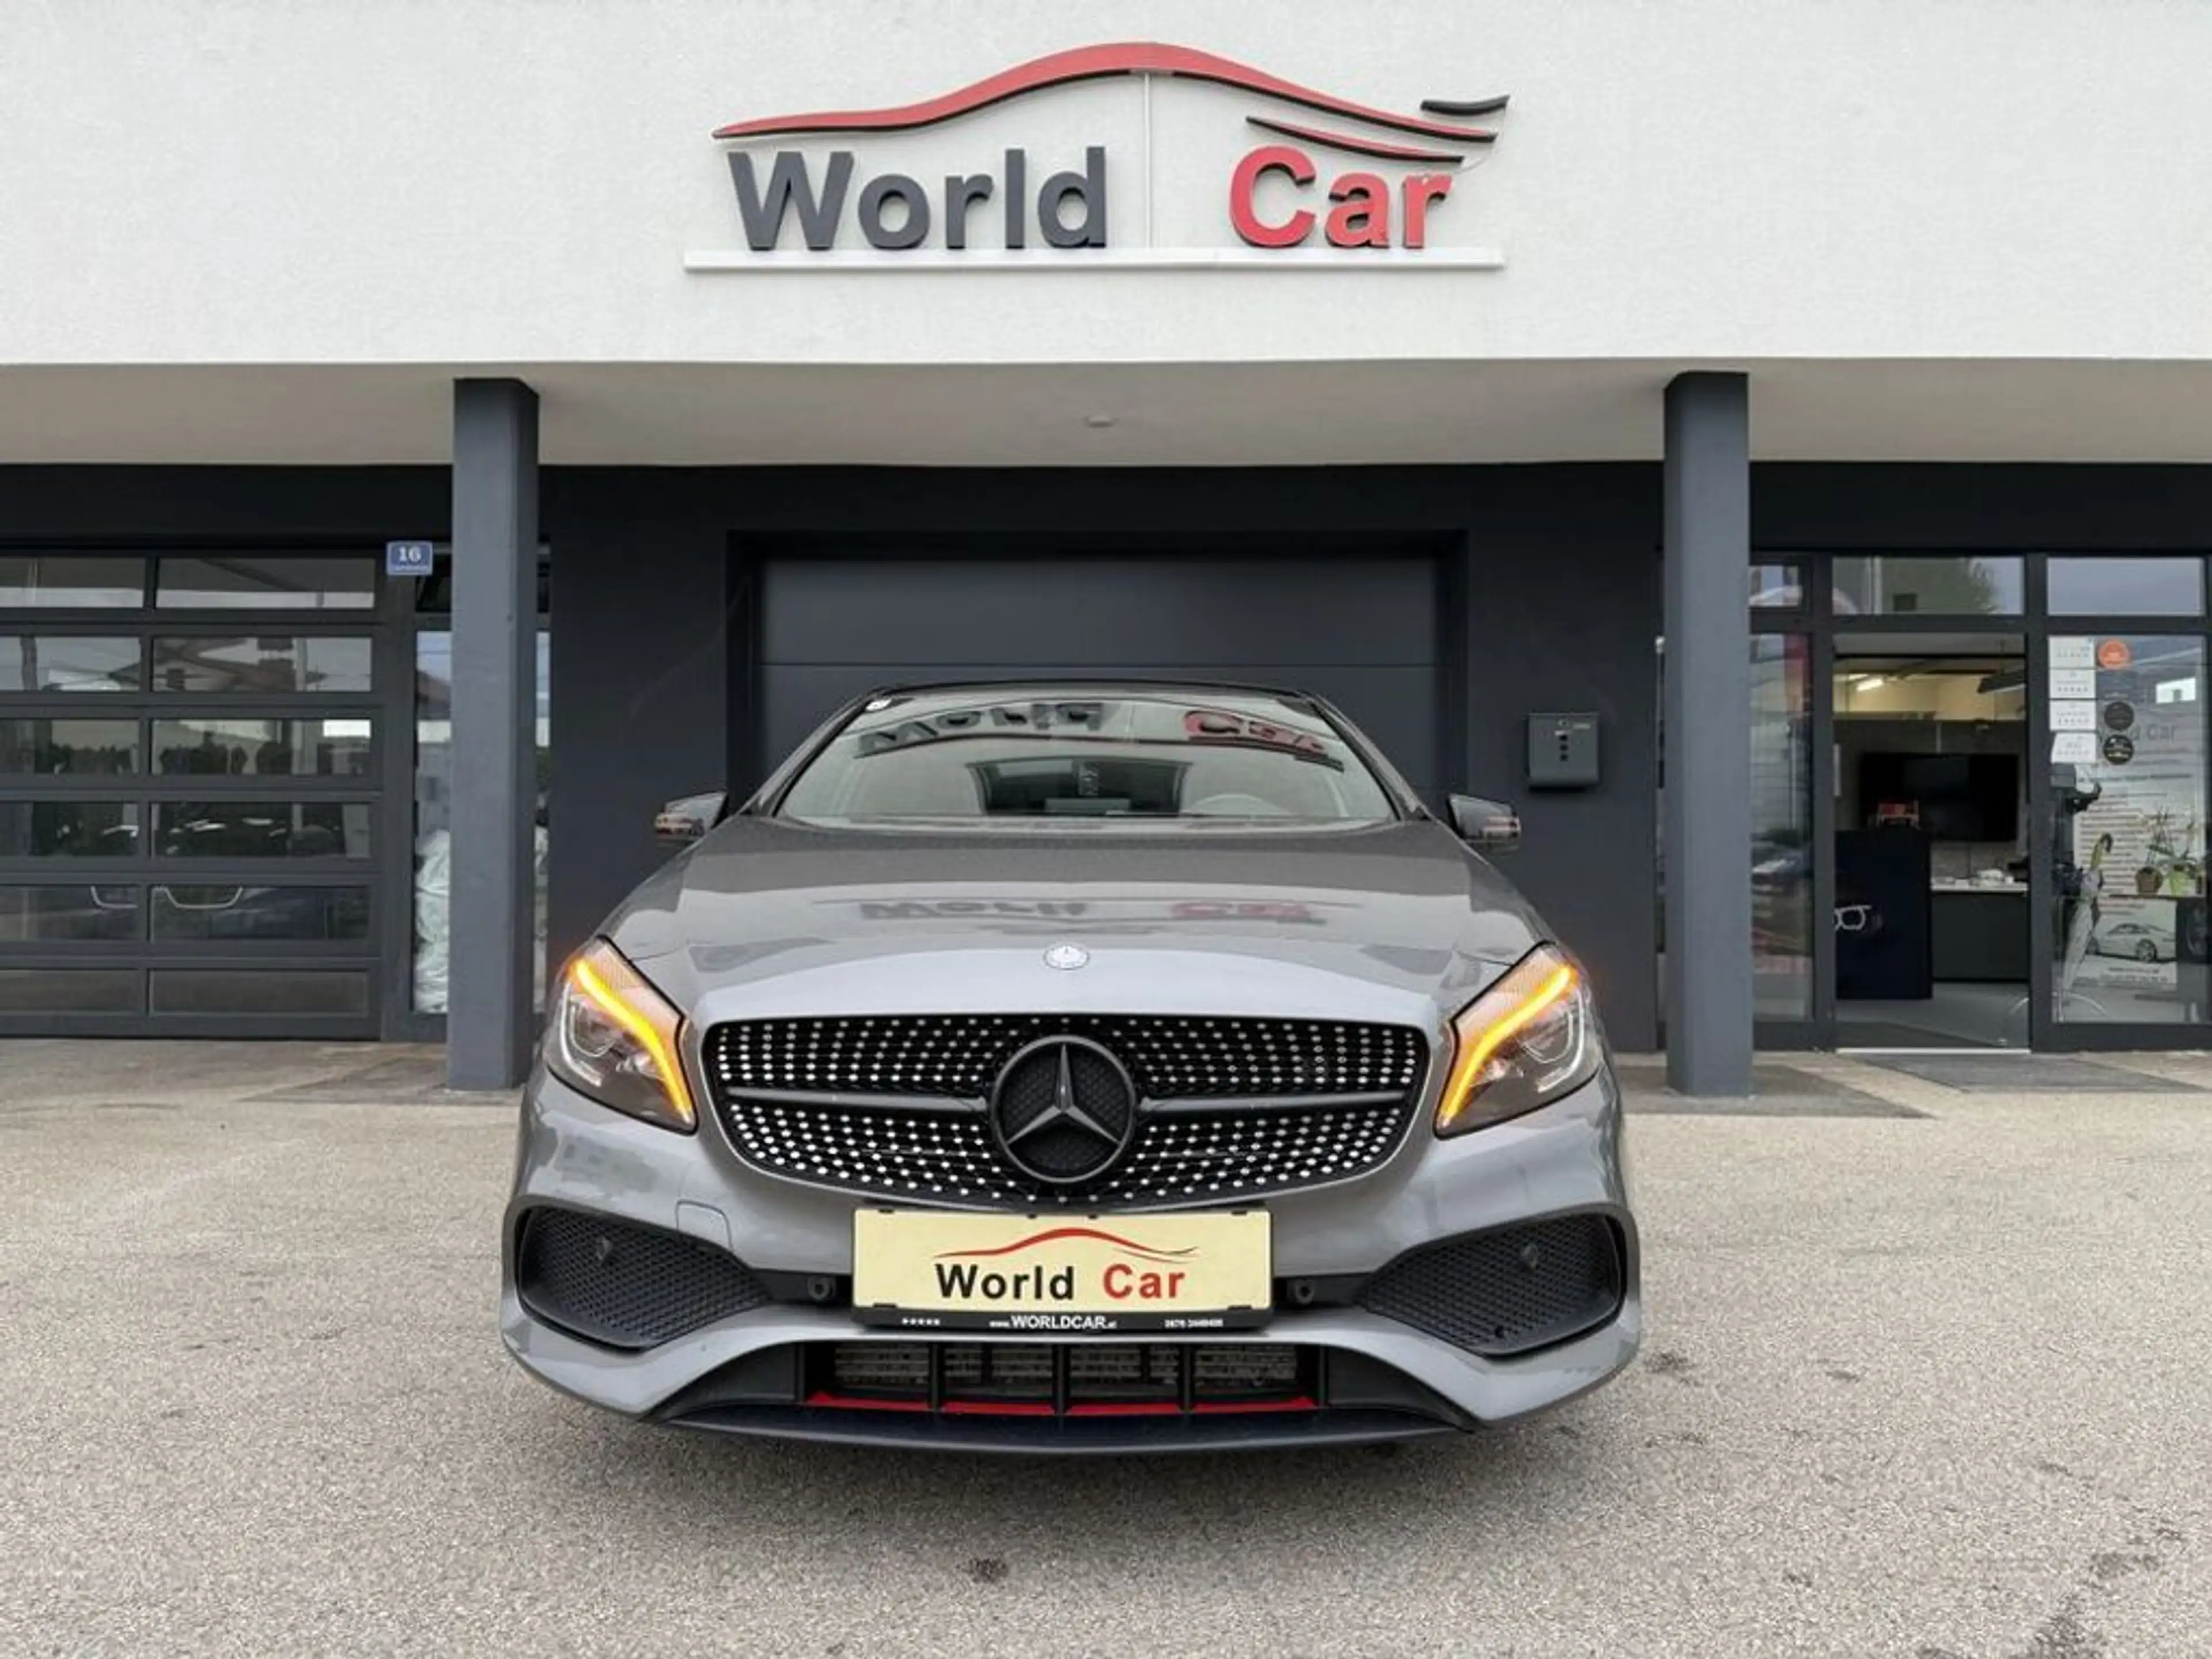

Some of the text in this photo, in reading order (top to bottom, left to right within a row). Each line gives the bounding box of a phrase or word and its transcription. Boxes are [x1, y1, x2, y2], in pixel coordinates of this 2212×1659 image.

[728, 146, 1452, 250] World Car
[400, 546, 422, 562] 16
[935, 1263, 1185, 1300] World Car
